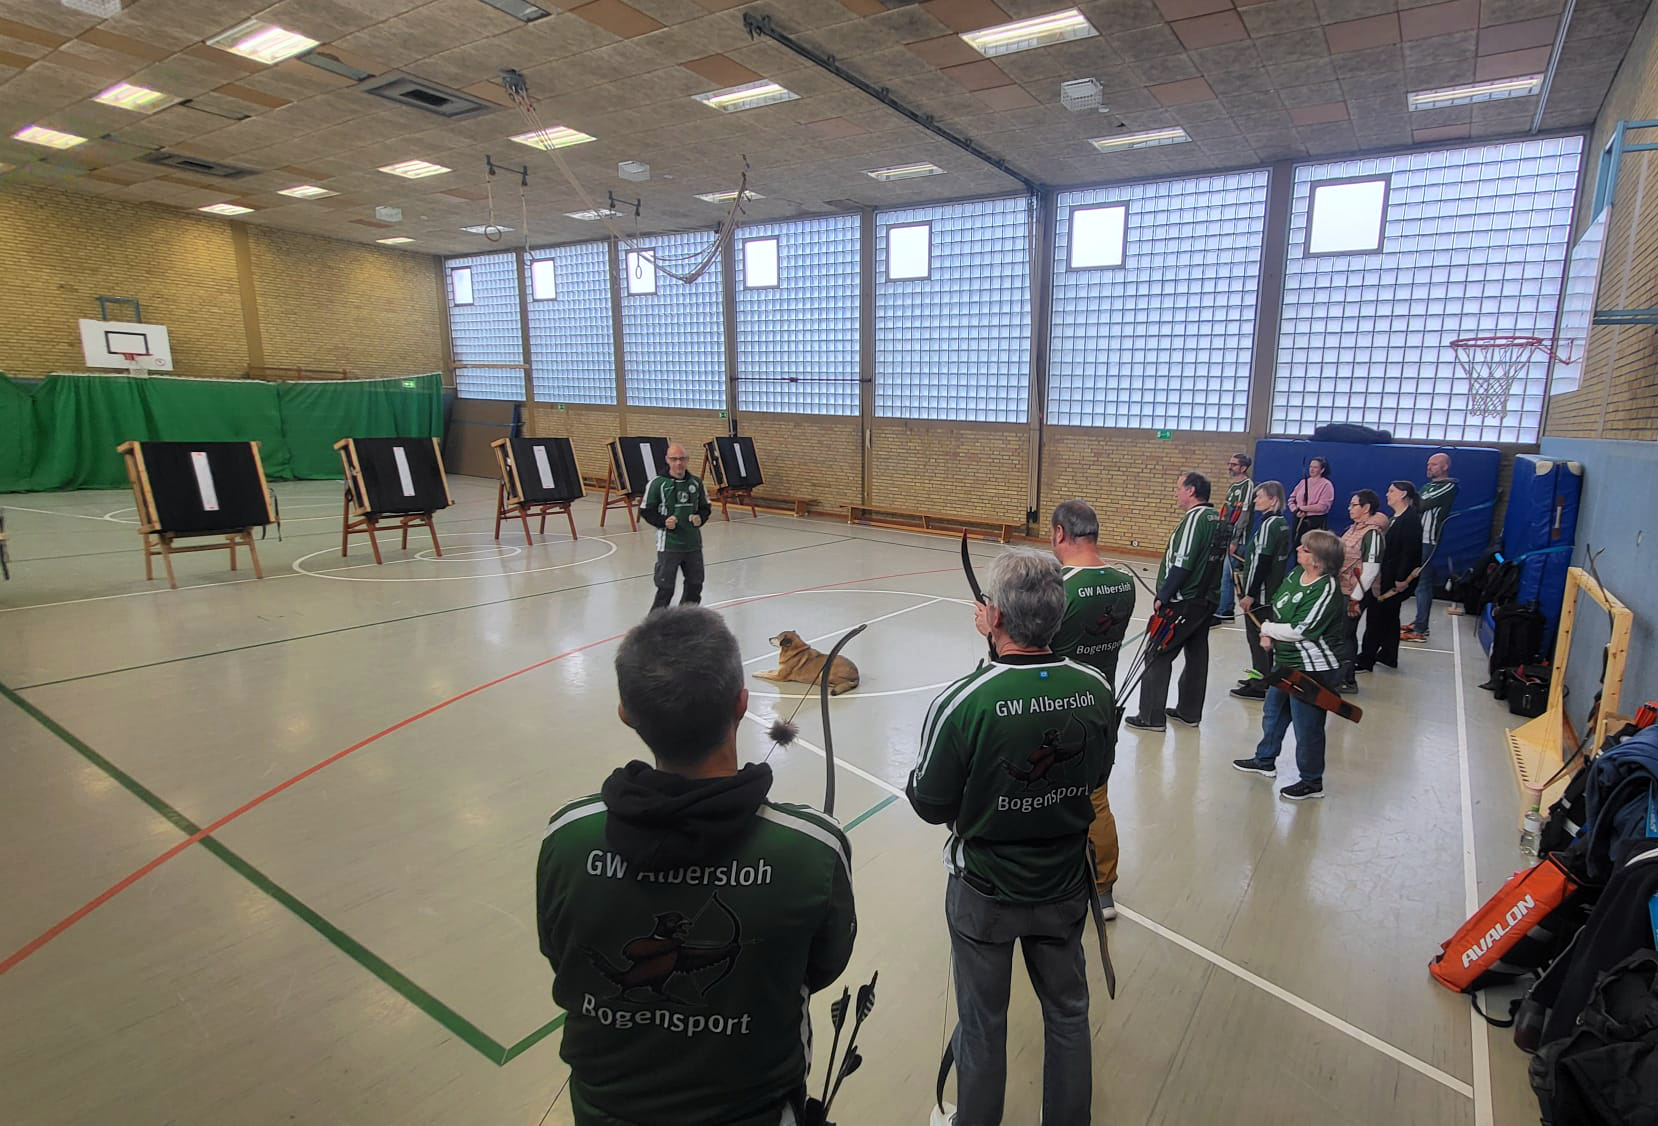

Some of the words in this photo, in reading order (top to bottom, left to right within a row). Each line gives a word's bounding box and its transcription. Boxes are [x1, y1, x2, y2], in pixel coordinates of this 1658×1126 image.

[1078, 586, 1094, 598] GW
[1096, 582, 1132, 596] Albersloh
[996, 699, 1023, 717] GW
[1030, 691, 1095, 714] Albersloh
[586, 849, 628, 879] GW
[1461, 893, 1536, 969] AVALON
